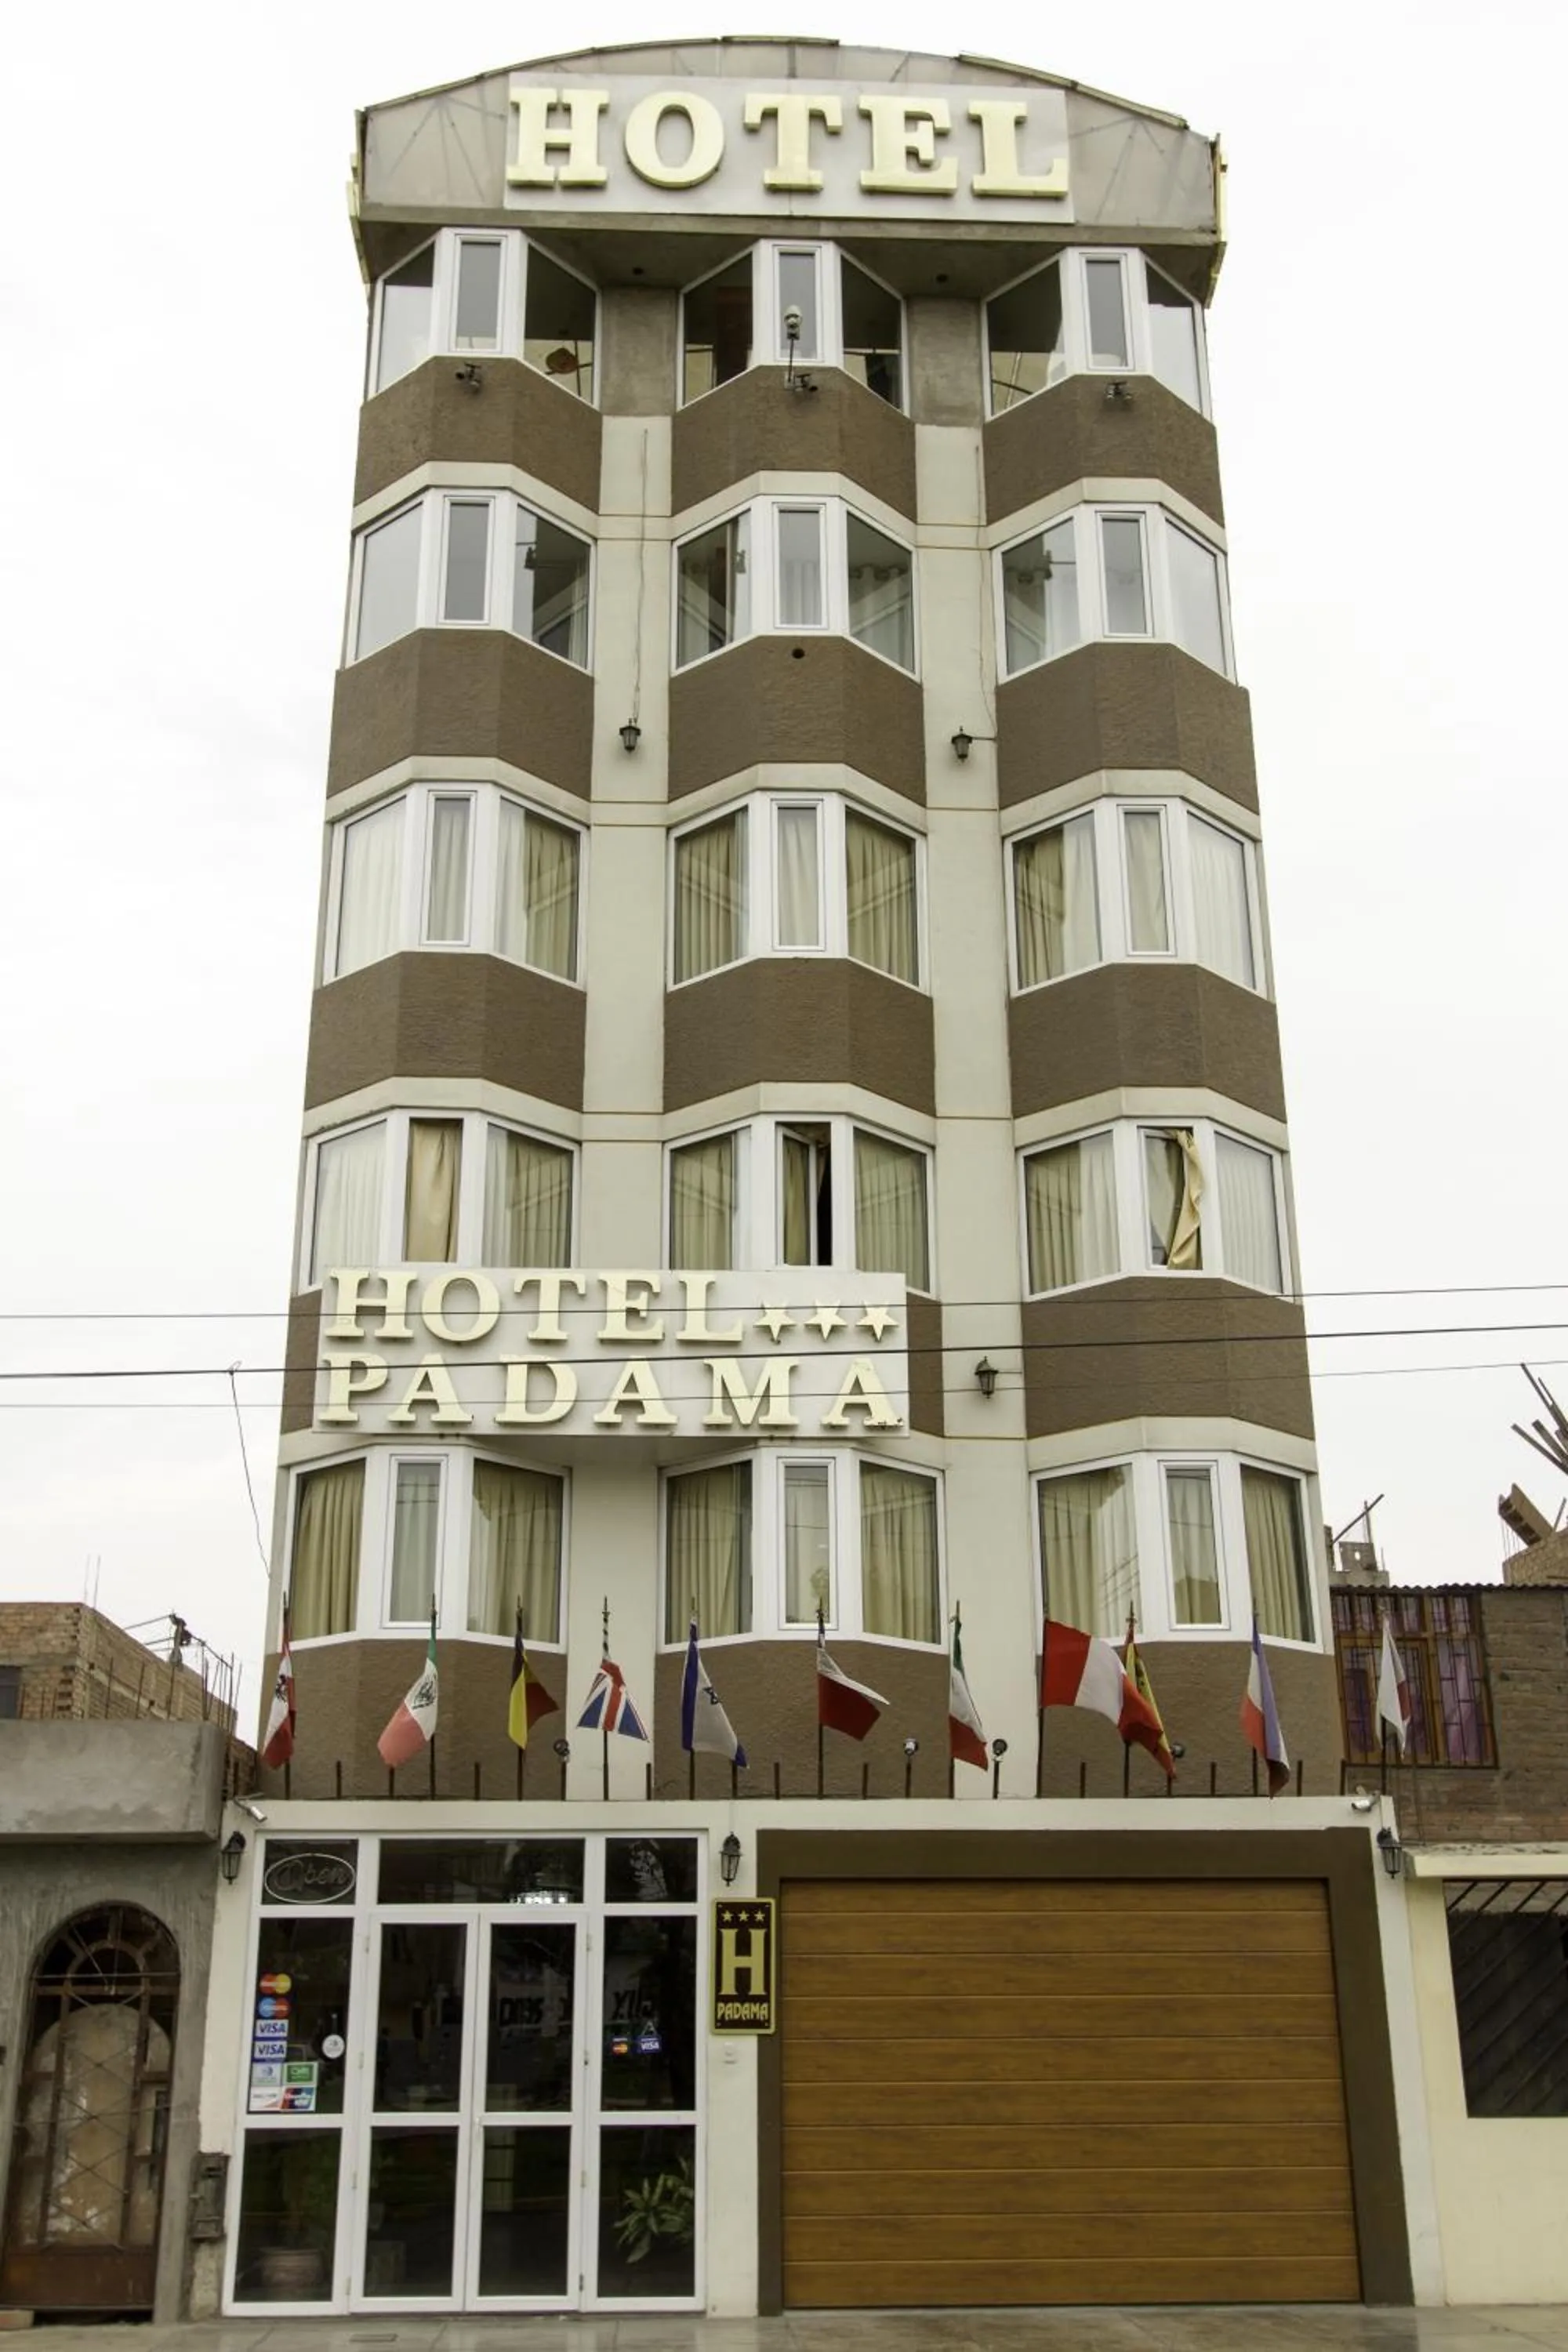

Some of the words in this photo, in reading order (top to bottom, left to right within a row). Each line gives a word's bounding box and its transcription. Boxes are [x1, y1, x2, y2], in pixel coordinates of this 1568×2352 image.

[506, 86, 1069, 198] HOTEL
[324, 1271, 744, 1343] HOTEL
[318, 1352, 906, 1429] PADAMA
[718, 1928, 768, 1995] H
[259, 2023, 287, 2034] VISA
[717, 2002, 769, 2020] PADAMA
[256, 2044, 285, 2055] VISA
